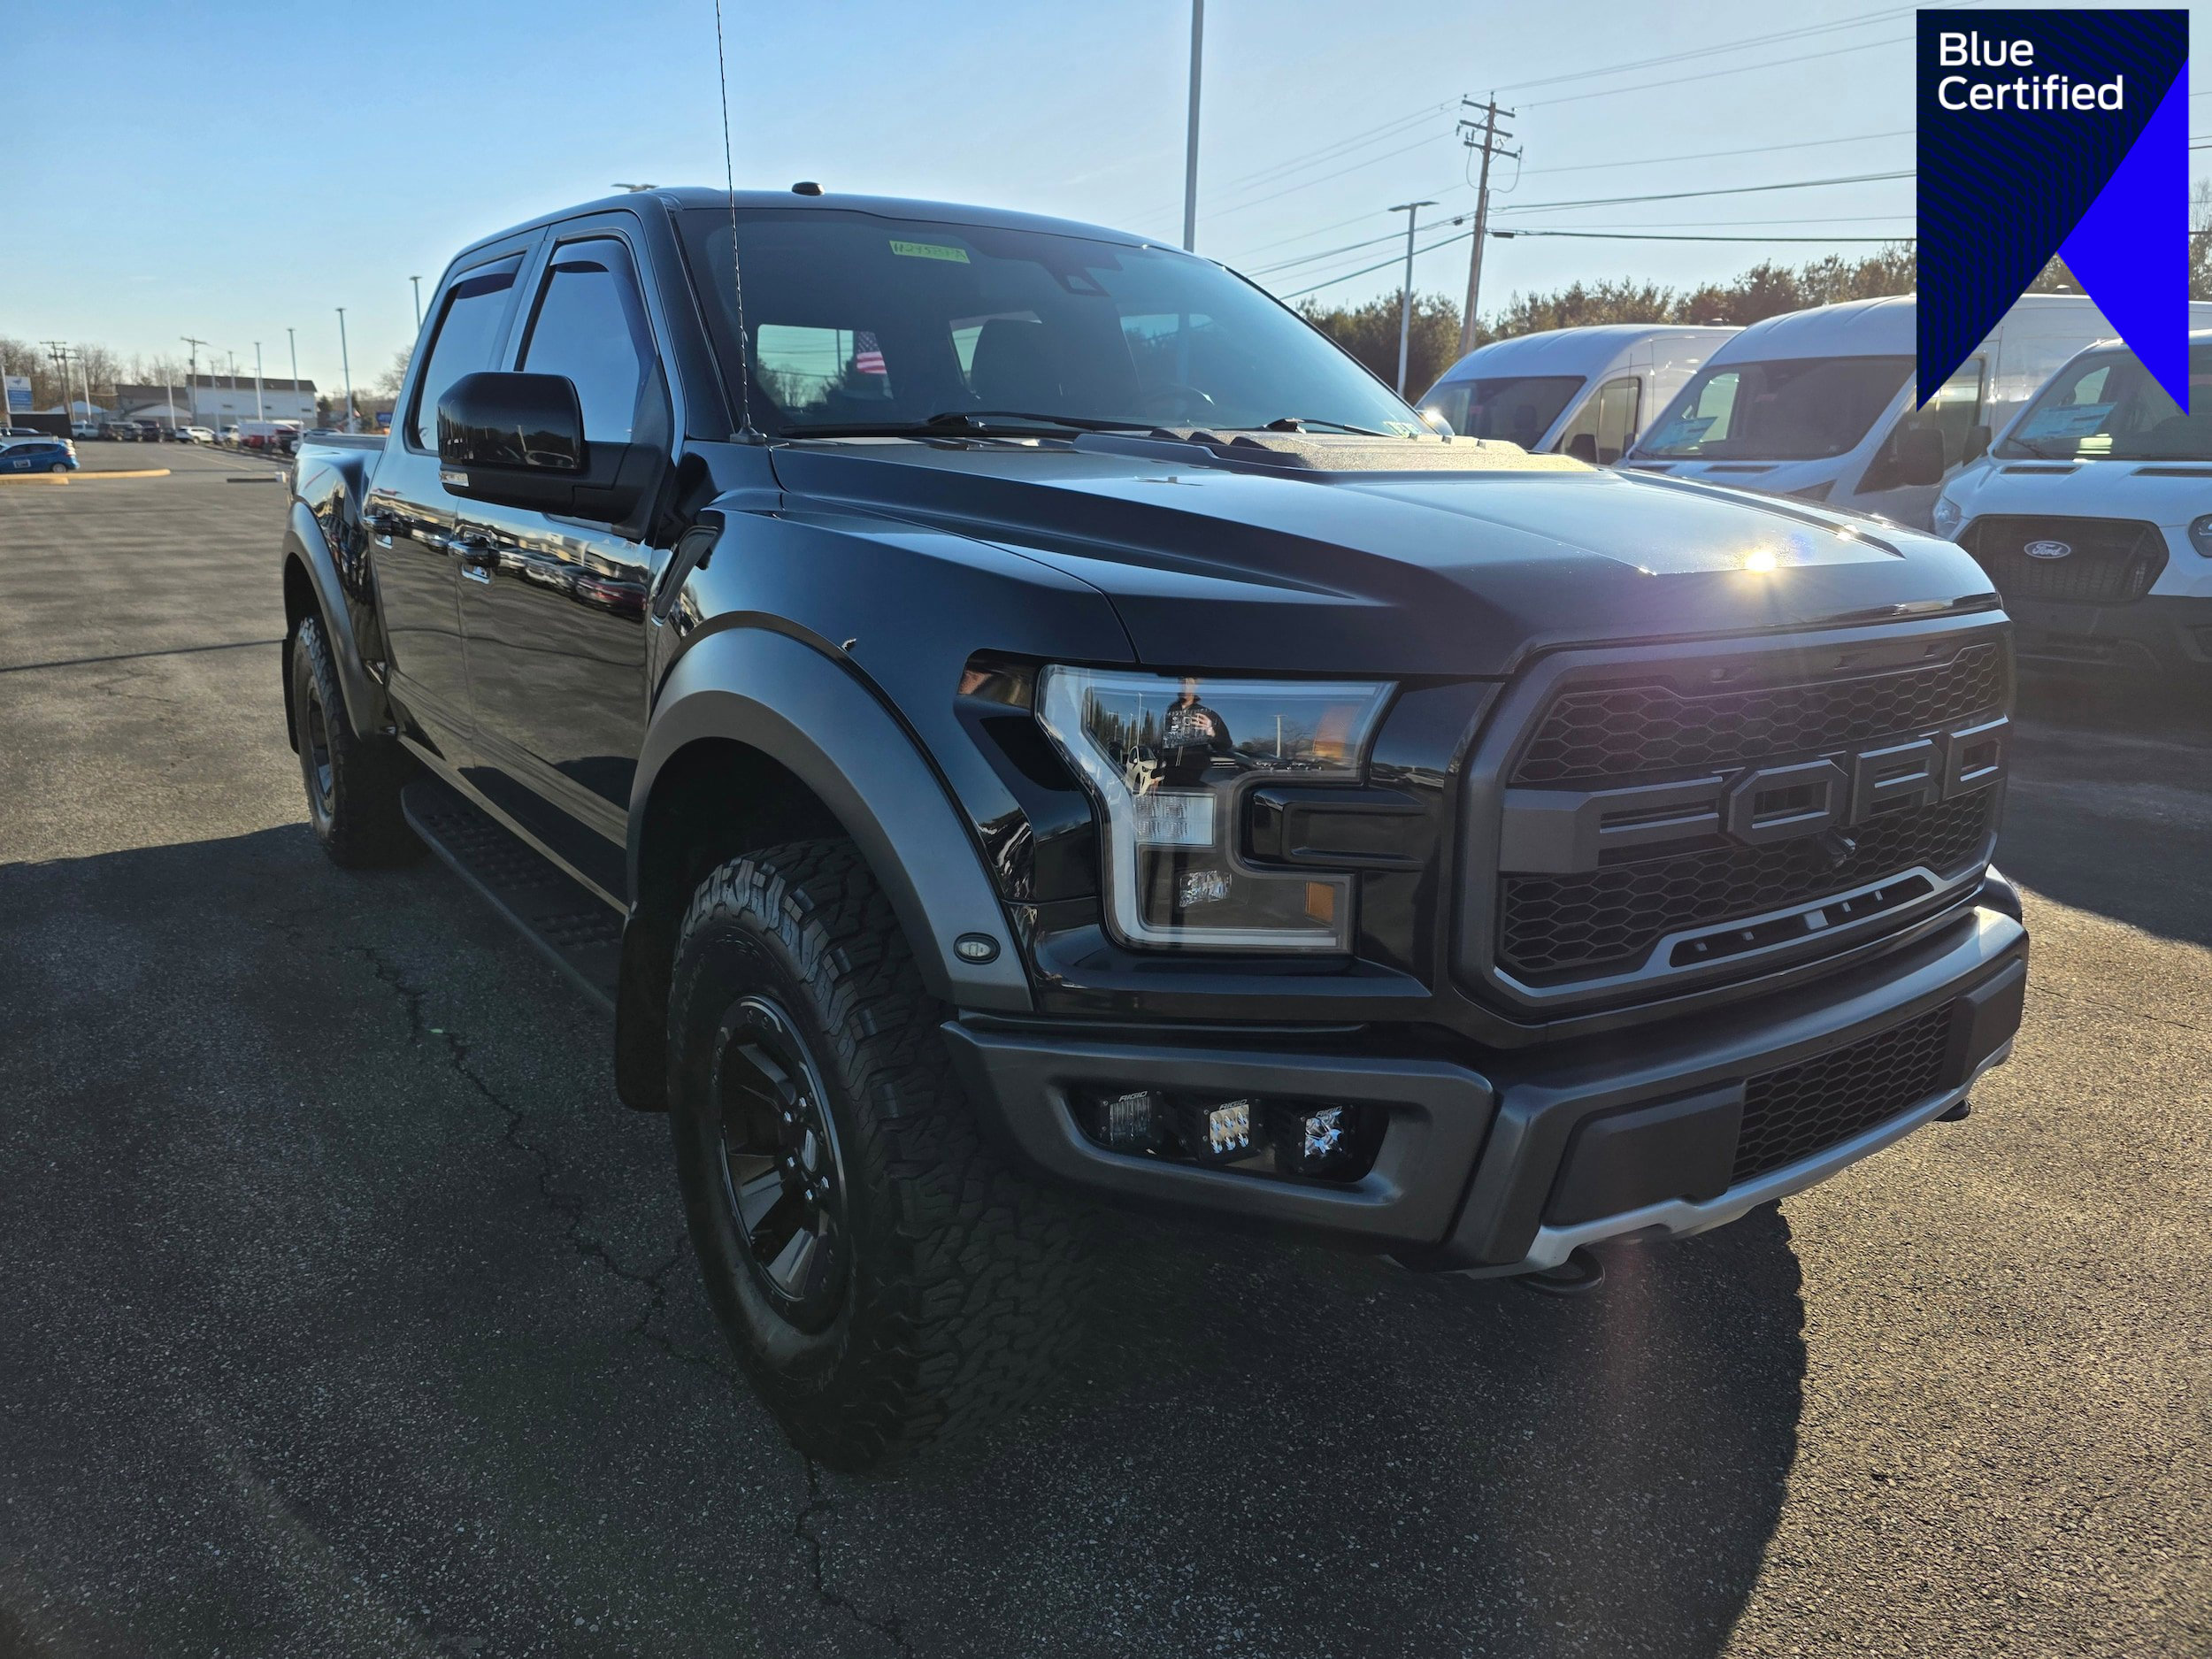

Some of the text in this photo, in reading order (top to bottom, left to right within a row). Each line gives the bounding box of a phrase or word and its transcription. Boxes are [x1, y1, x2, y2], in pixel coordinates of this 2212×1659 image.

[2032, 542, 2062, 556] Ford
[1573, 713, 2010, 874] FORD
[1118, 1090, 1148, 1102] RIGID
[1218, 1098, 1248, 1110] RIGID
